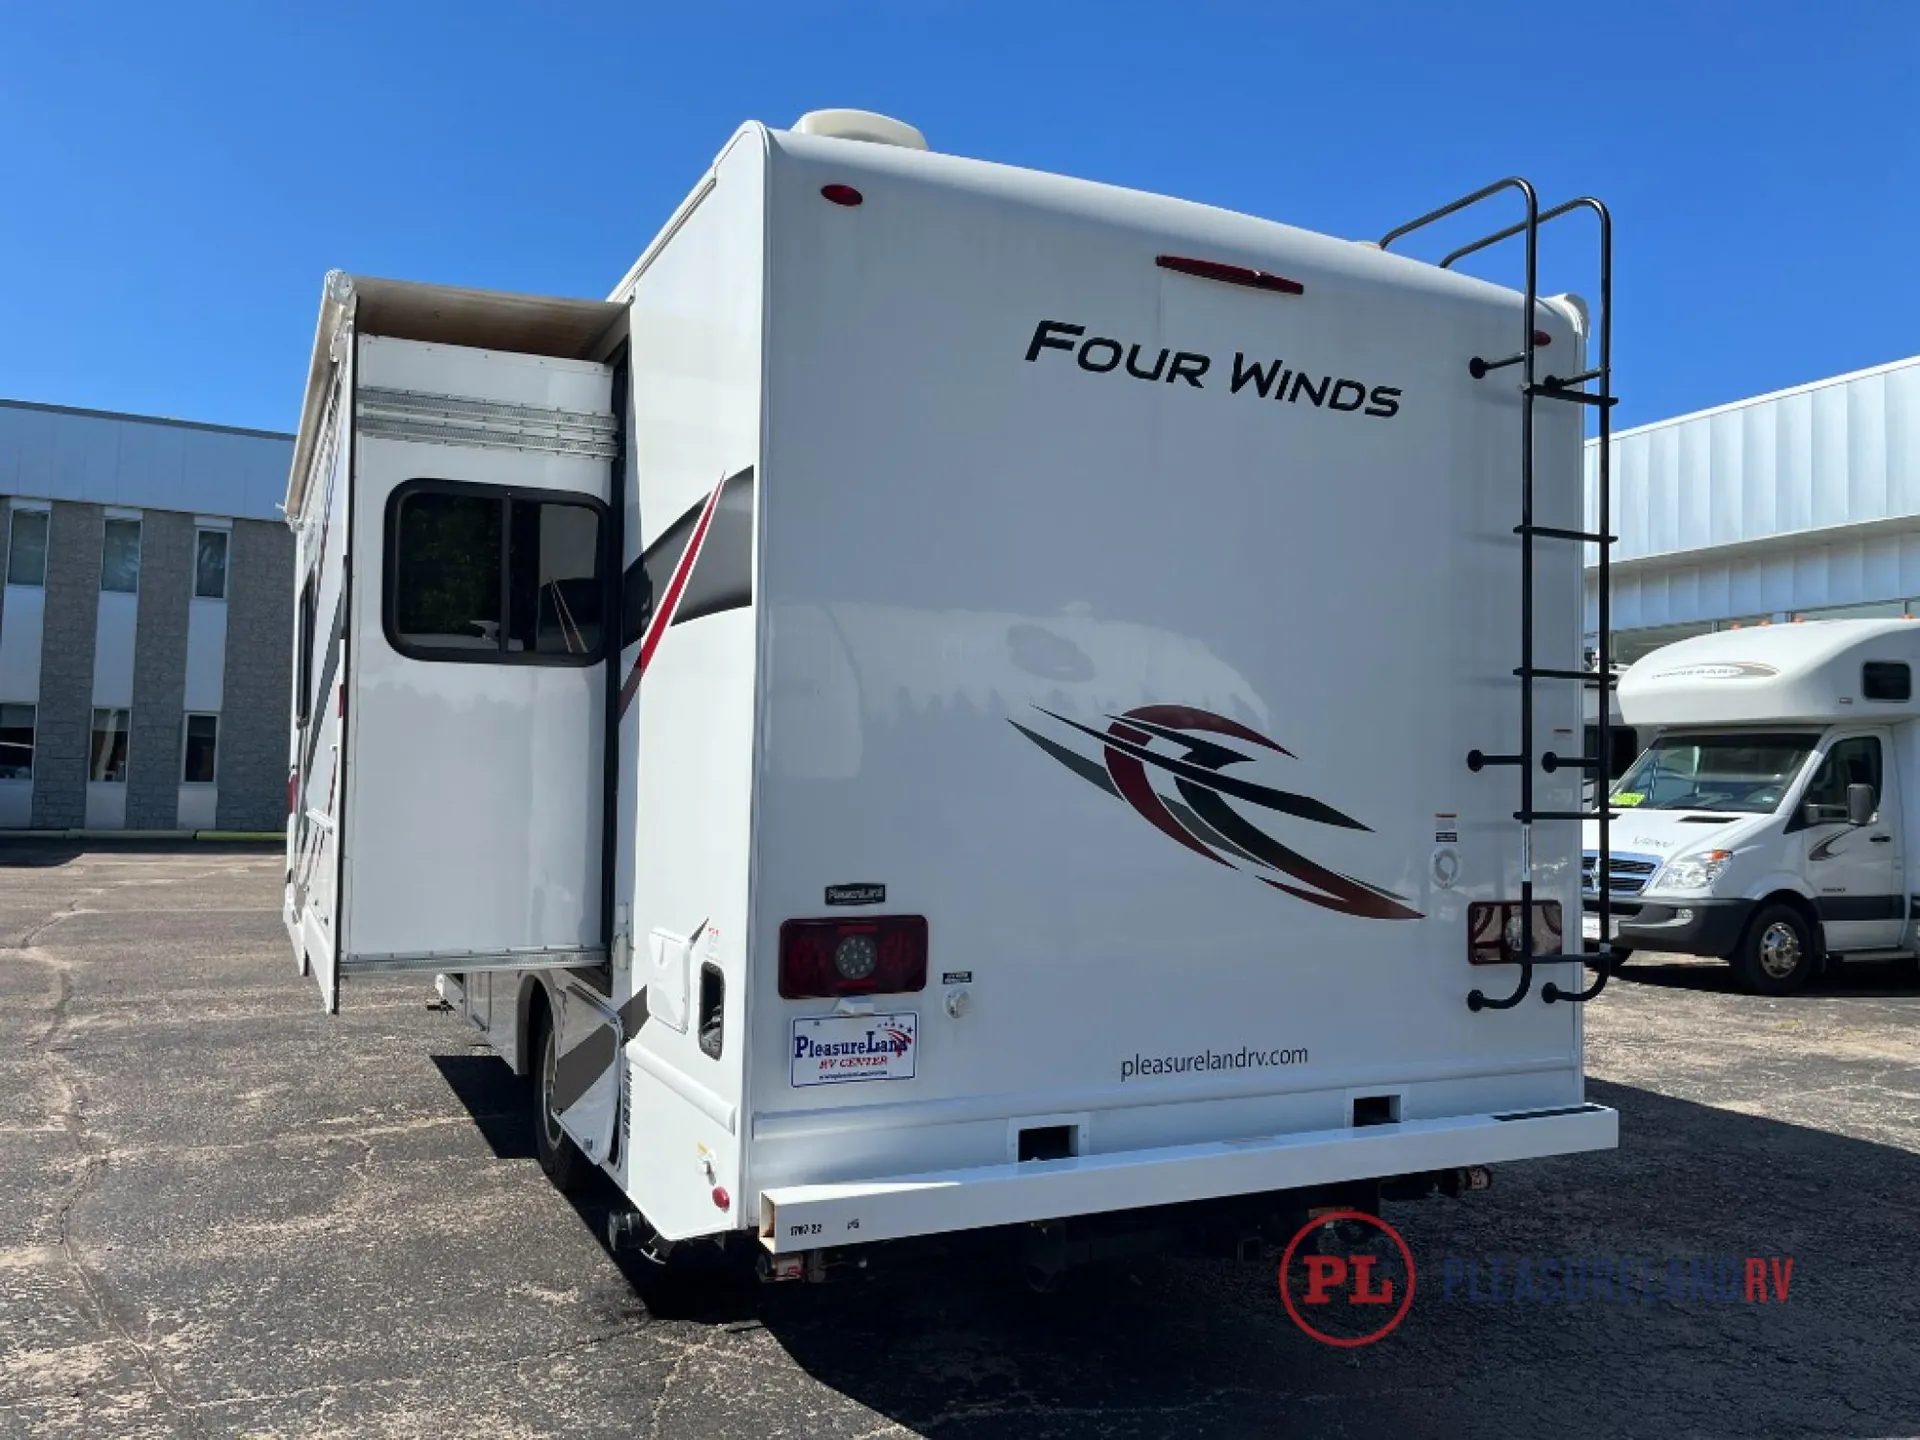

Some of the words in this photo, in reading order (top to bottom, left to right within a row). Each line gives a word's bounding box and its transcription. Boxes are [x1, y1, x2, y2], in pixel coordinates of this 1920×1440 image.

[1025, 320, 1211, 388] FOUR
[1230, 352, 1402, 417] WINDS
[819, 1059, 837, 1070] RV
[839, 1055, 888, 1068] CENTER
[1120, 1046, 1309, 1083] pleasurelandrv.com
